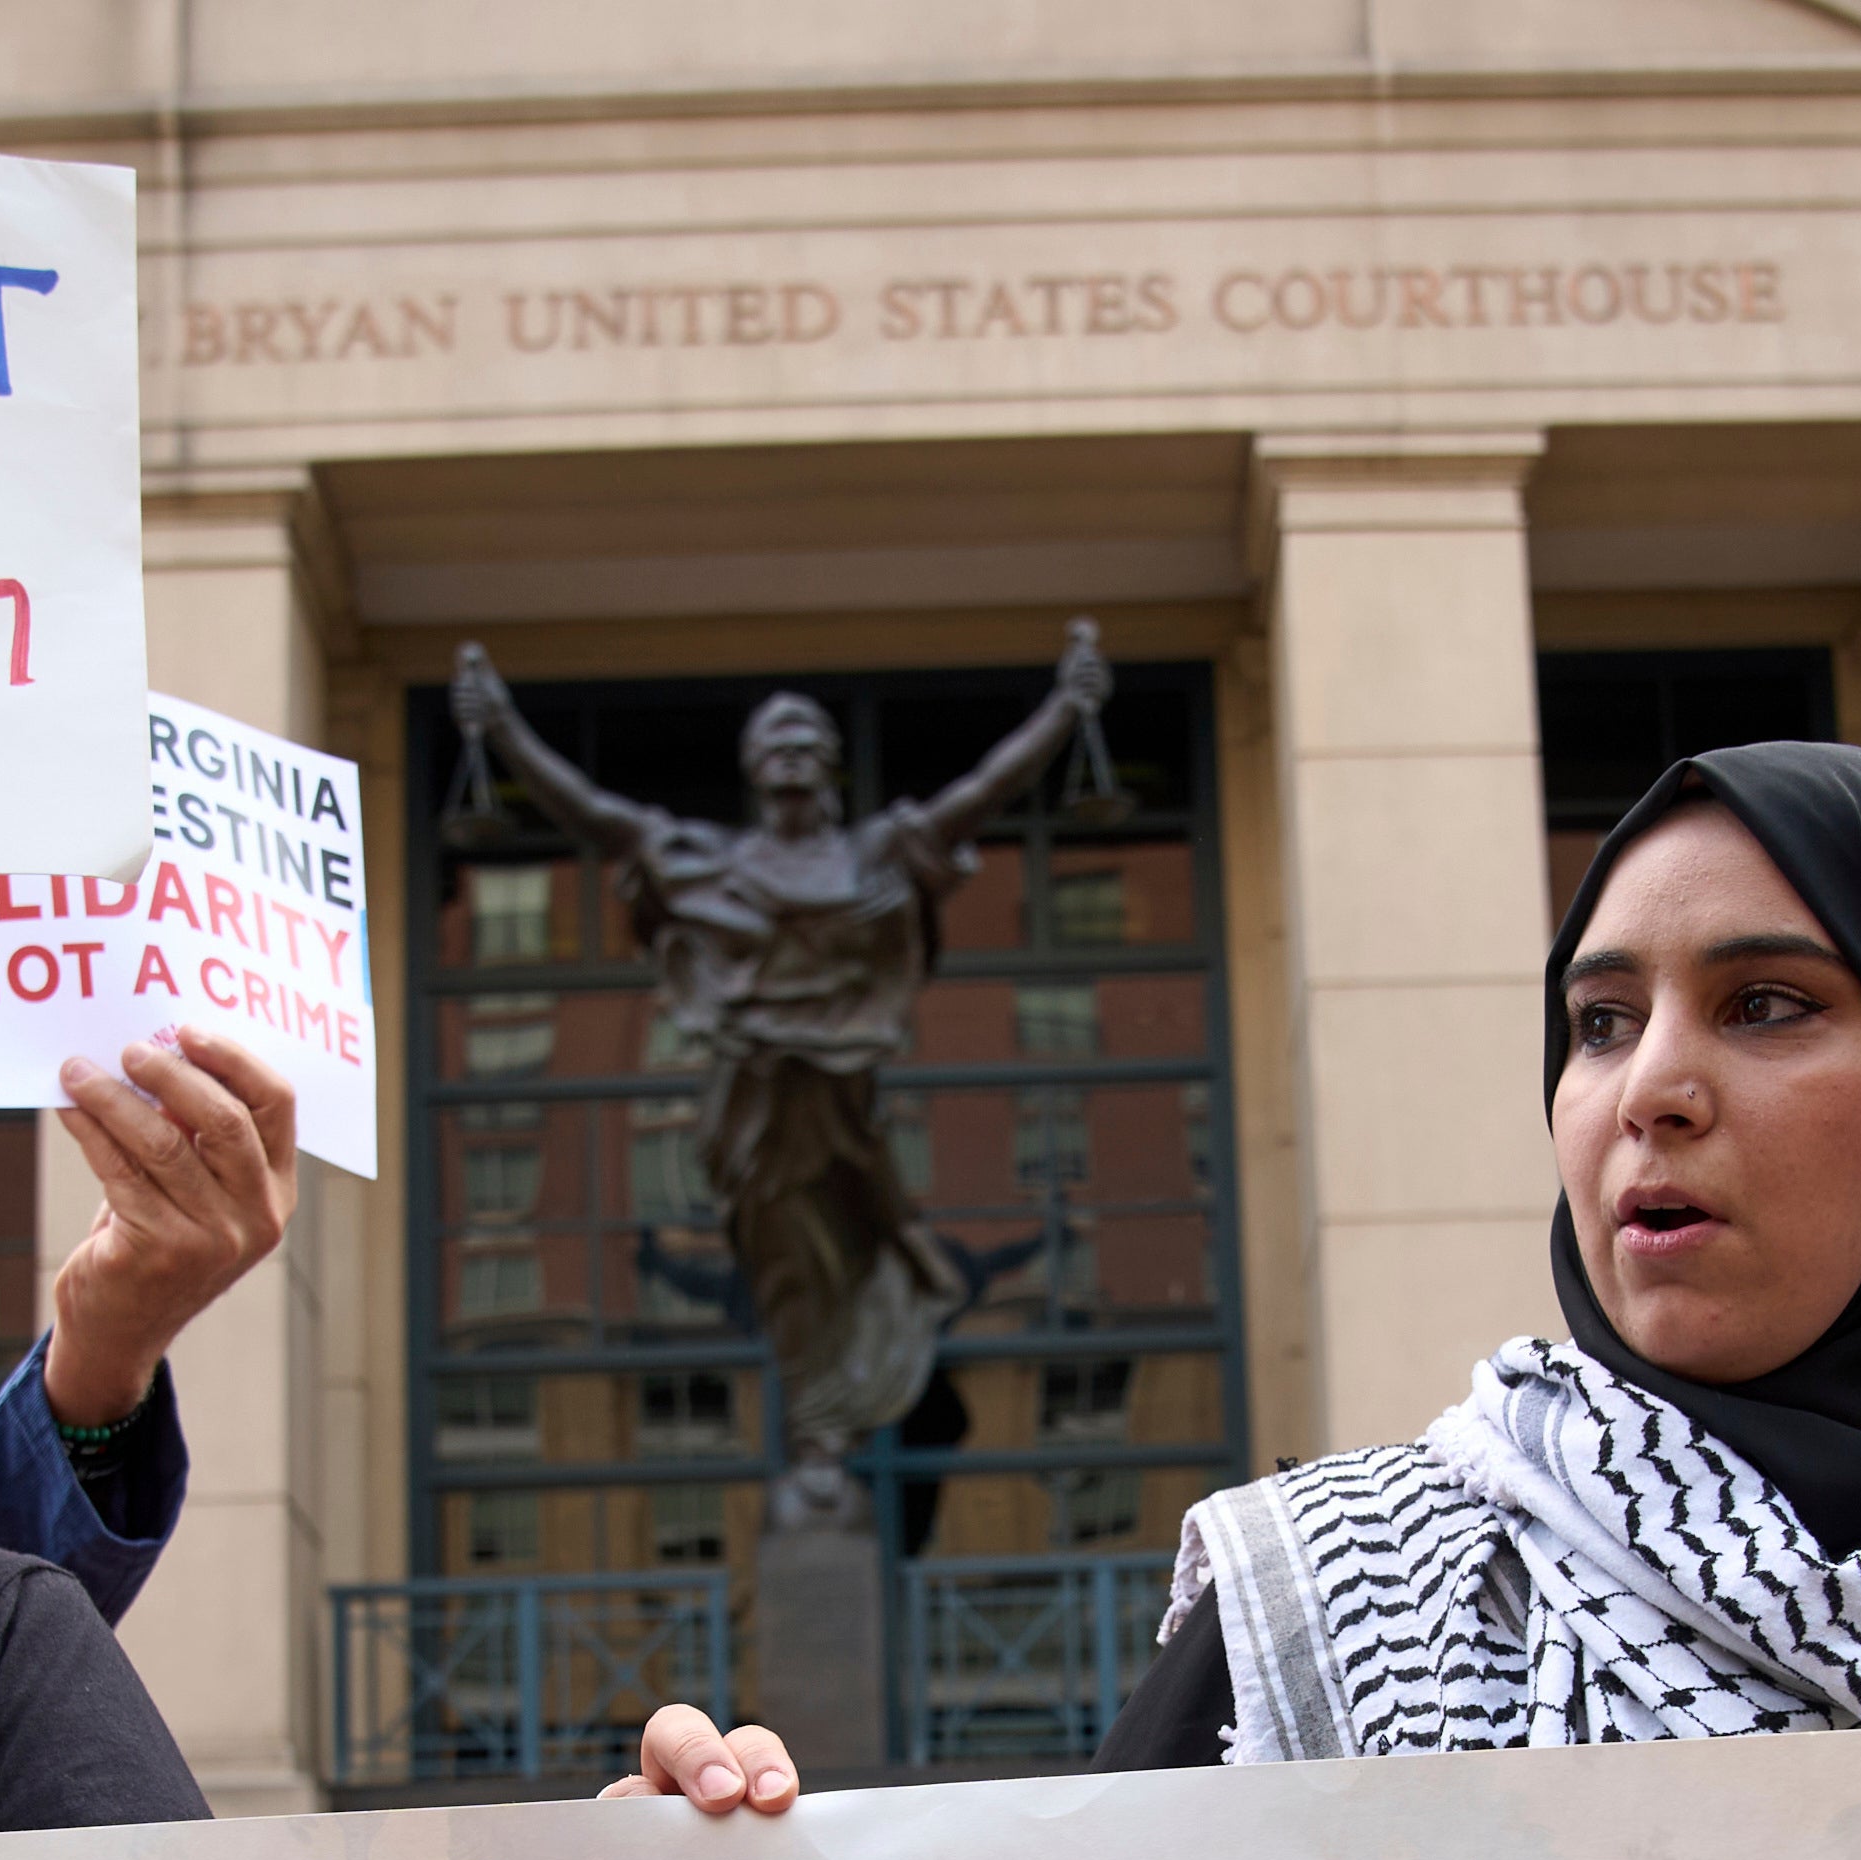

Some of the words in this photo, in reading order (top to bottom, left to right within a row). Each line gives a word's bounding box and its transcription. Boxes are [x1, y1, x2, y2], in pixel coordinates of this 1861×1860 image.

[181, 294, 458, 366] BRYAN
[504, 279, 843, 354] UNITED
[876, 271, 1180, 343] STATES
[1209, 260, 1788, 333] COURTHOUSE
[148, 713, 348, 832] RGINIA
[151, 784, 355, 911] ESTINE
[133, 943, 181, 998] A
[200, 957, 362, 1067] CRIME
